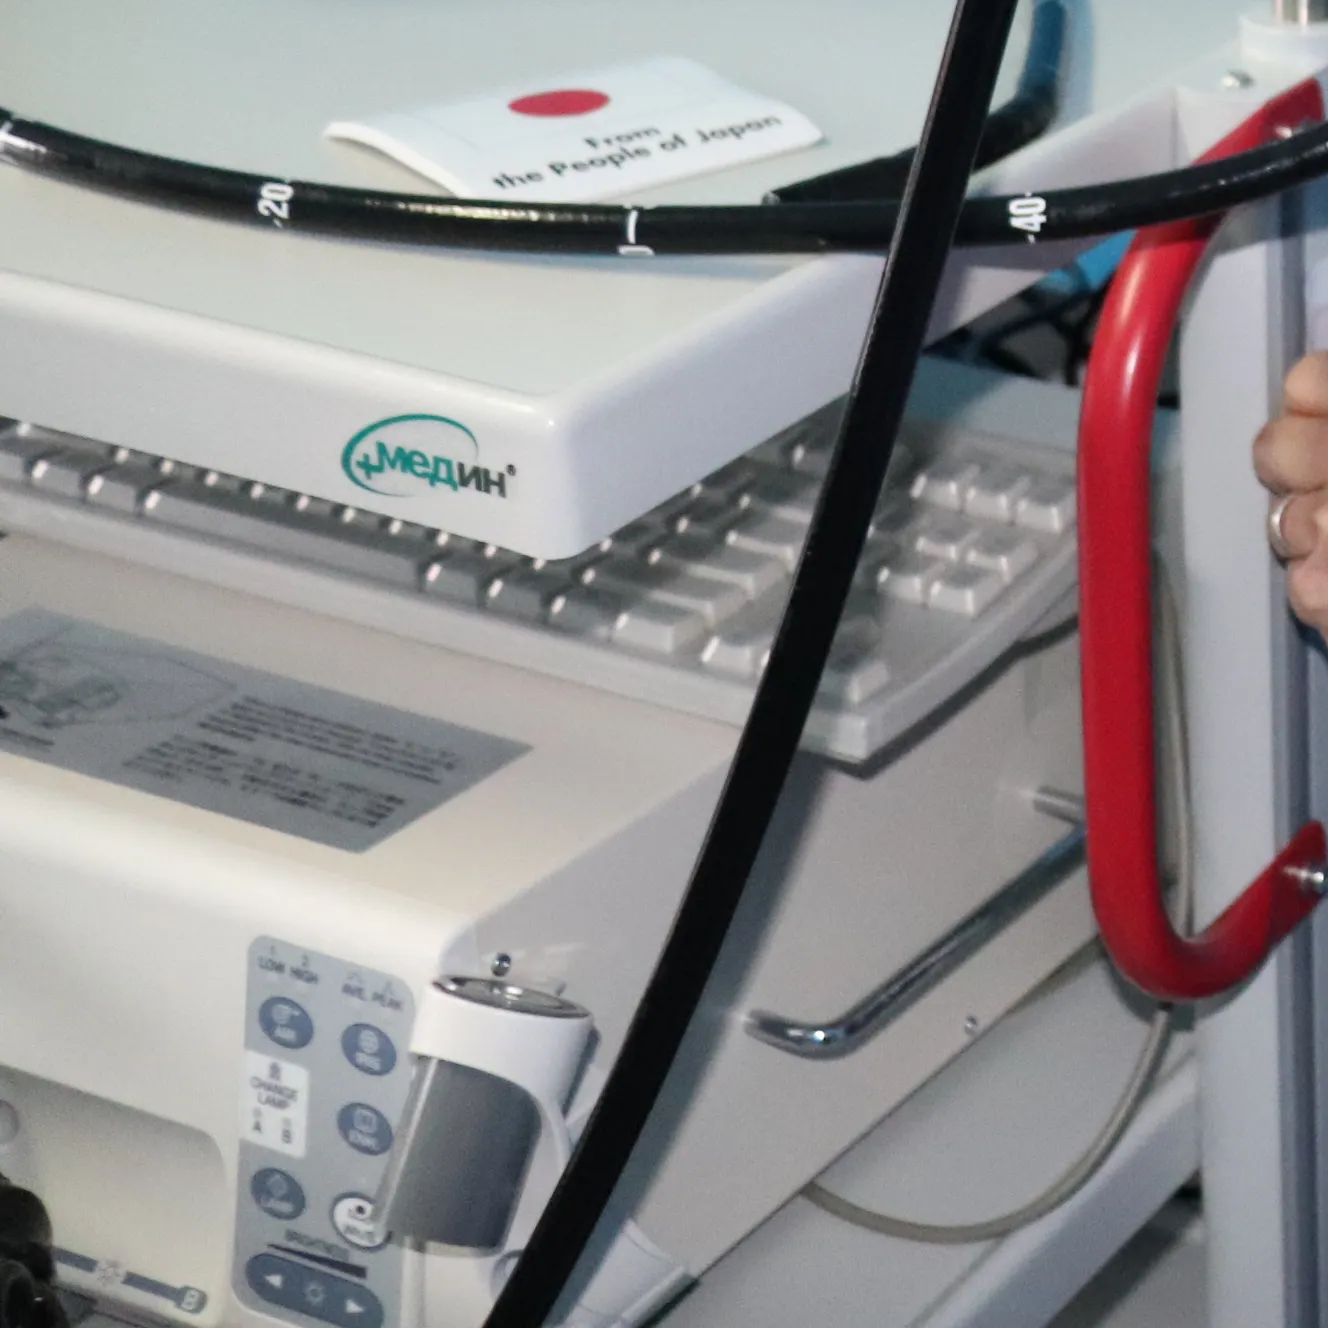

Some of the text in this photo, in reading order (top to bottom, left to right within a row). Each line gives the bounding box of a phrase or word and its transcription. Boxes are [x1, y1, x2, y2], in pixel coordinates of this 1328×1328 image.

[492, 115, 782, 189] the People of Japan
[583, 125, 661, 149] From
[257, 182, 294, 219] 20
[1008, 196, 1047, 233] 40
